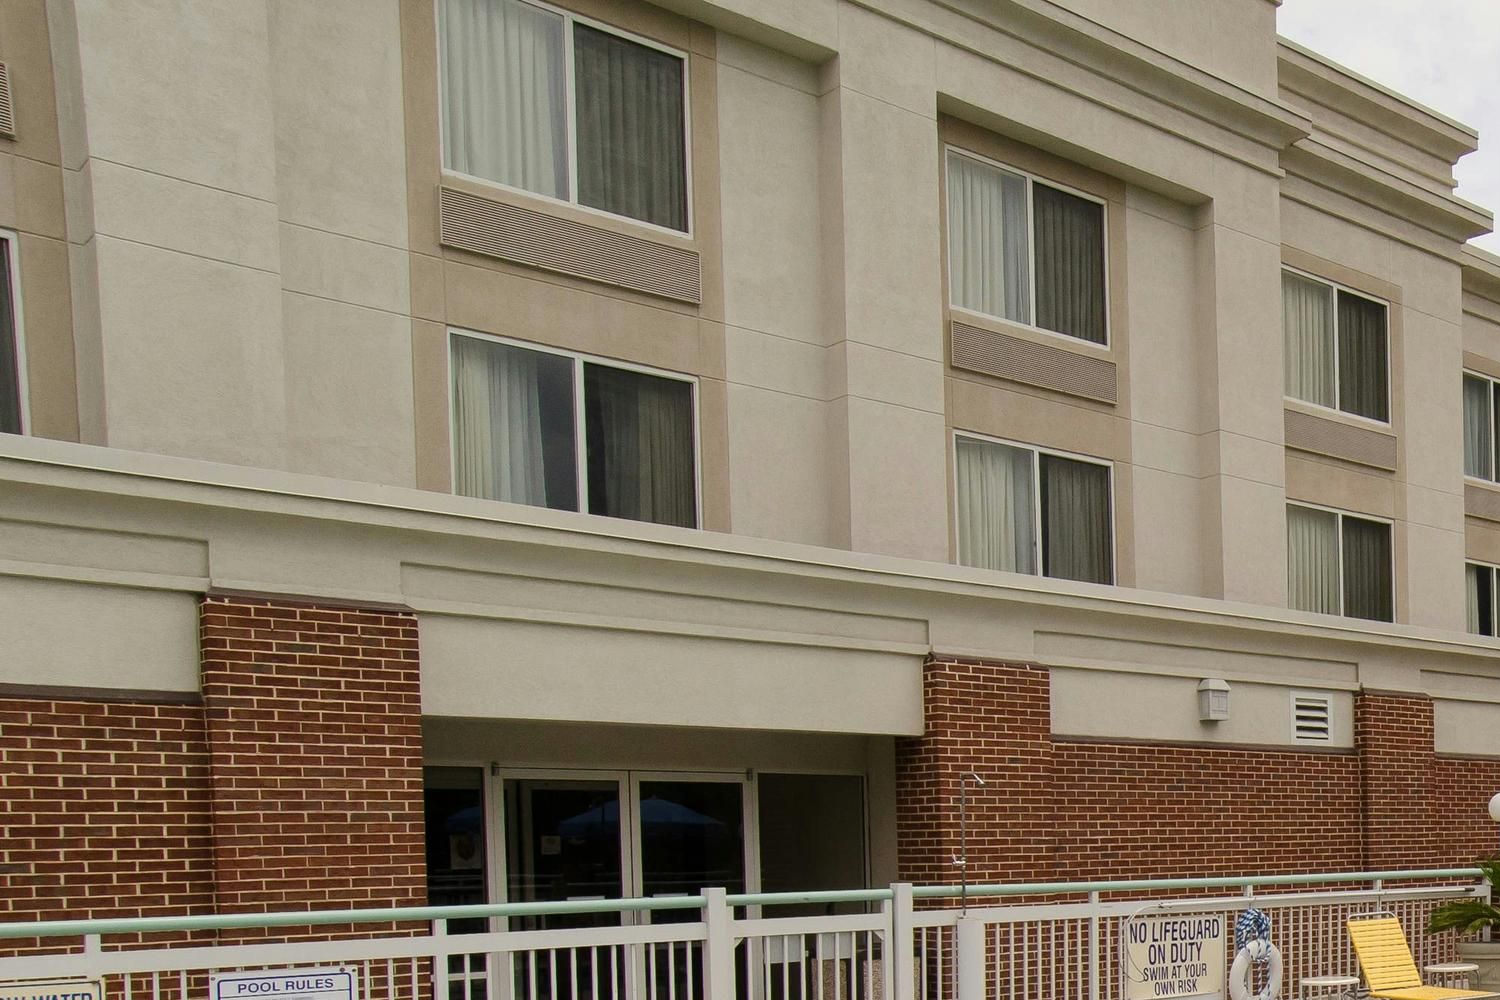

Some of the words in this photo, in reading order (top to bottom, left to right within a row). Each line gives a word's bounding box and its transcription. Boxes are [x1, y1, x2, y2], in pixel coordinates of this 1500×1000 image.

[1130, 922, 1147, 944] NO
[1152, 919, 1220, 943] LIFEGUARD
[1148, 944, 1166, 965] ON
[1171, 941, 1203, 963] DUTY
[1143, 966, 1169, 981] SWIM
[1171, 965, 1182, 979] AT
[1184, 963, 1207, 978] YOUR
[237, 982, 281, 994] POOL
[285, 978, 334, 991] RULES
[1154, 981, 1175, 996] OWN
[1178, 979, 1198, 994] RISK
